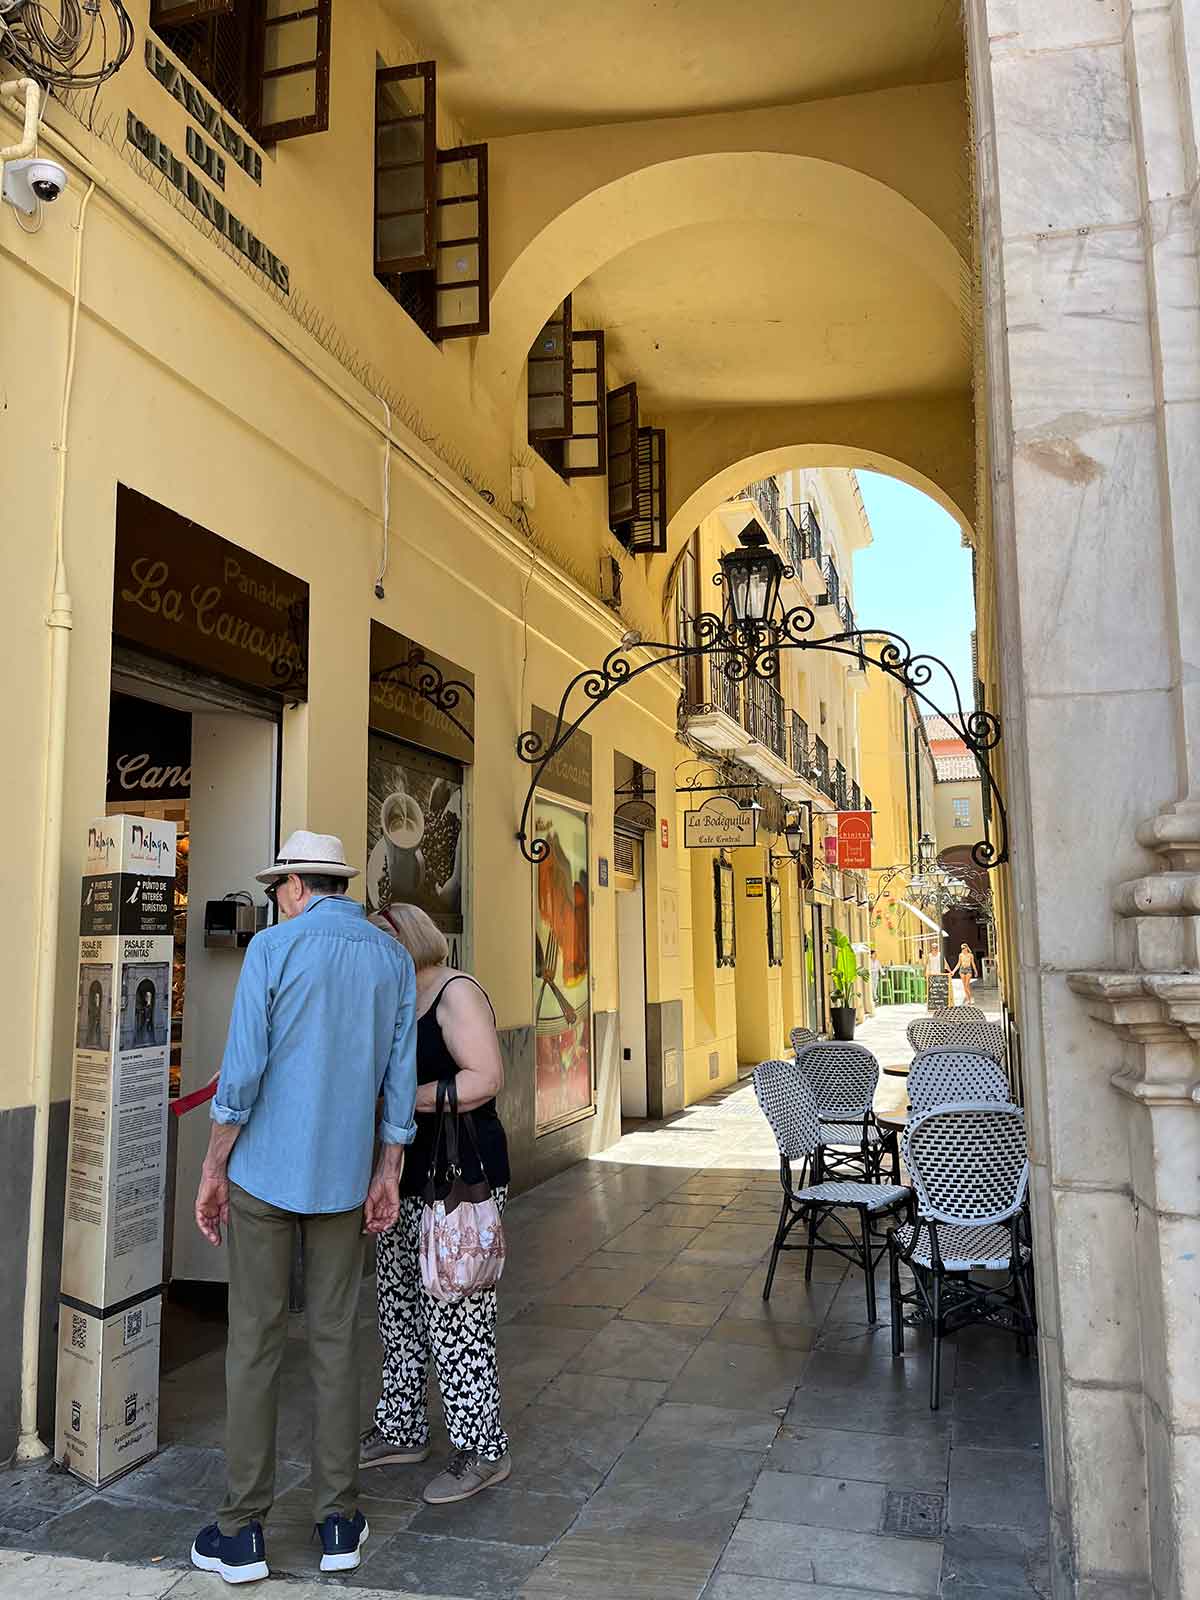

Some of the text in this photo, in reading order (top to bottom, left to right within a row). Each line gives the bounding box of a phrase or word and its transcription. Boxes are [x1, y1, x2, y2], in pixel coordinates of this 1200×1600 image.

[147, 40, 263, 186] PASAJE
[187, 126, 226, 191] DE
[121, 557, 184, 622] La
[688, 815, 701, 827] La
[131, 824, 169, 866] Málaga
[142, 881, 167, 890] PUNTO DE
[142, 891, 163, 901] INTERÉS
[142, 903, 167, 912] TURÍSTICO
[124, 940, 154, 949] PASAJE DE
[124, 949, 149, 958] CHINITAS
